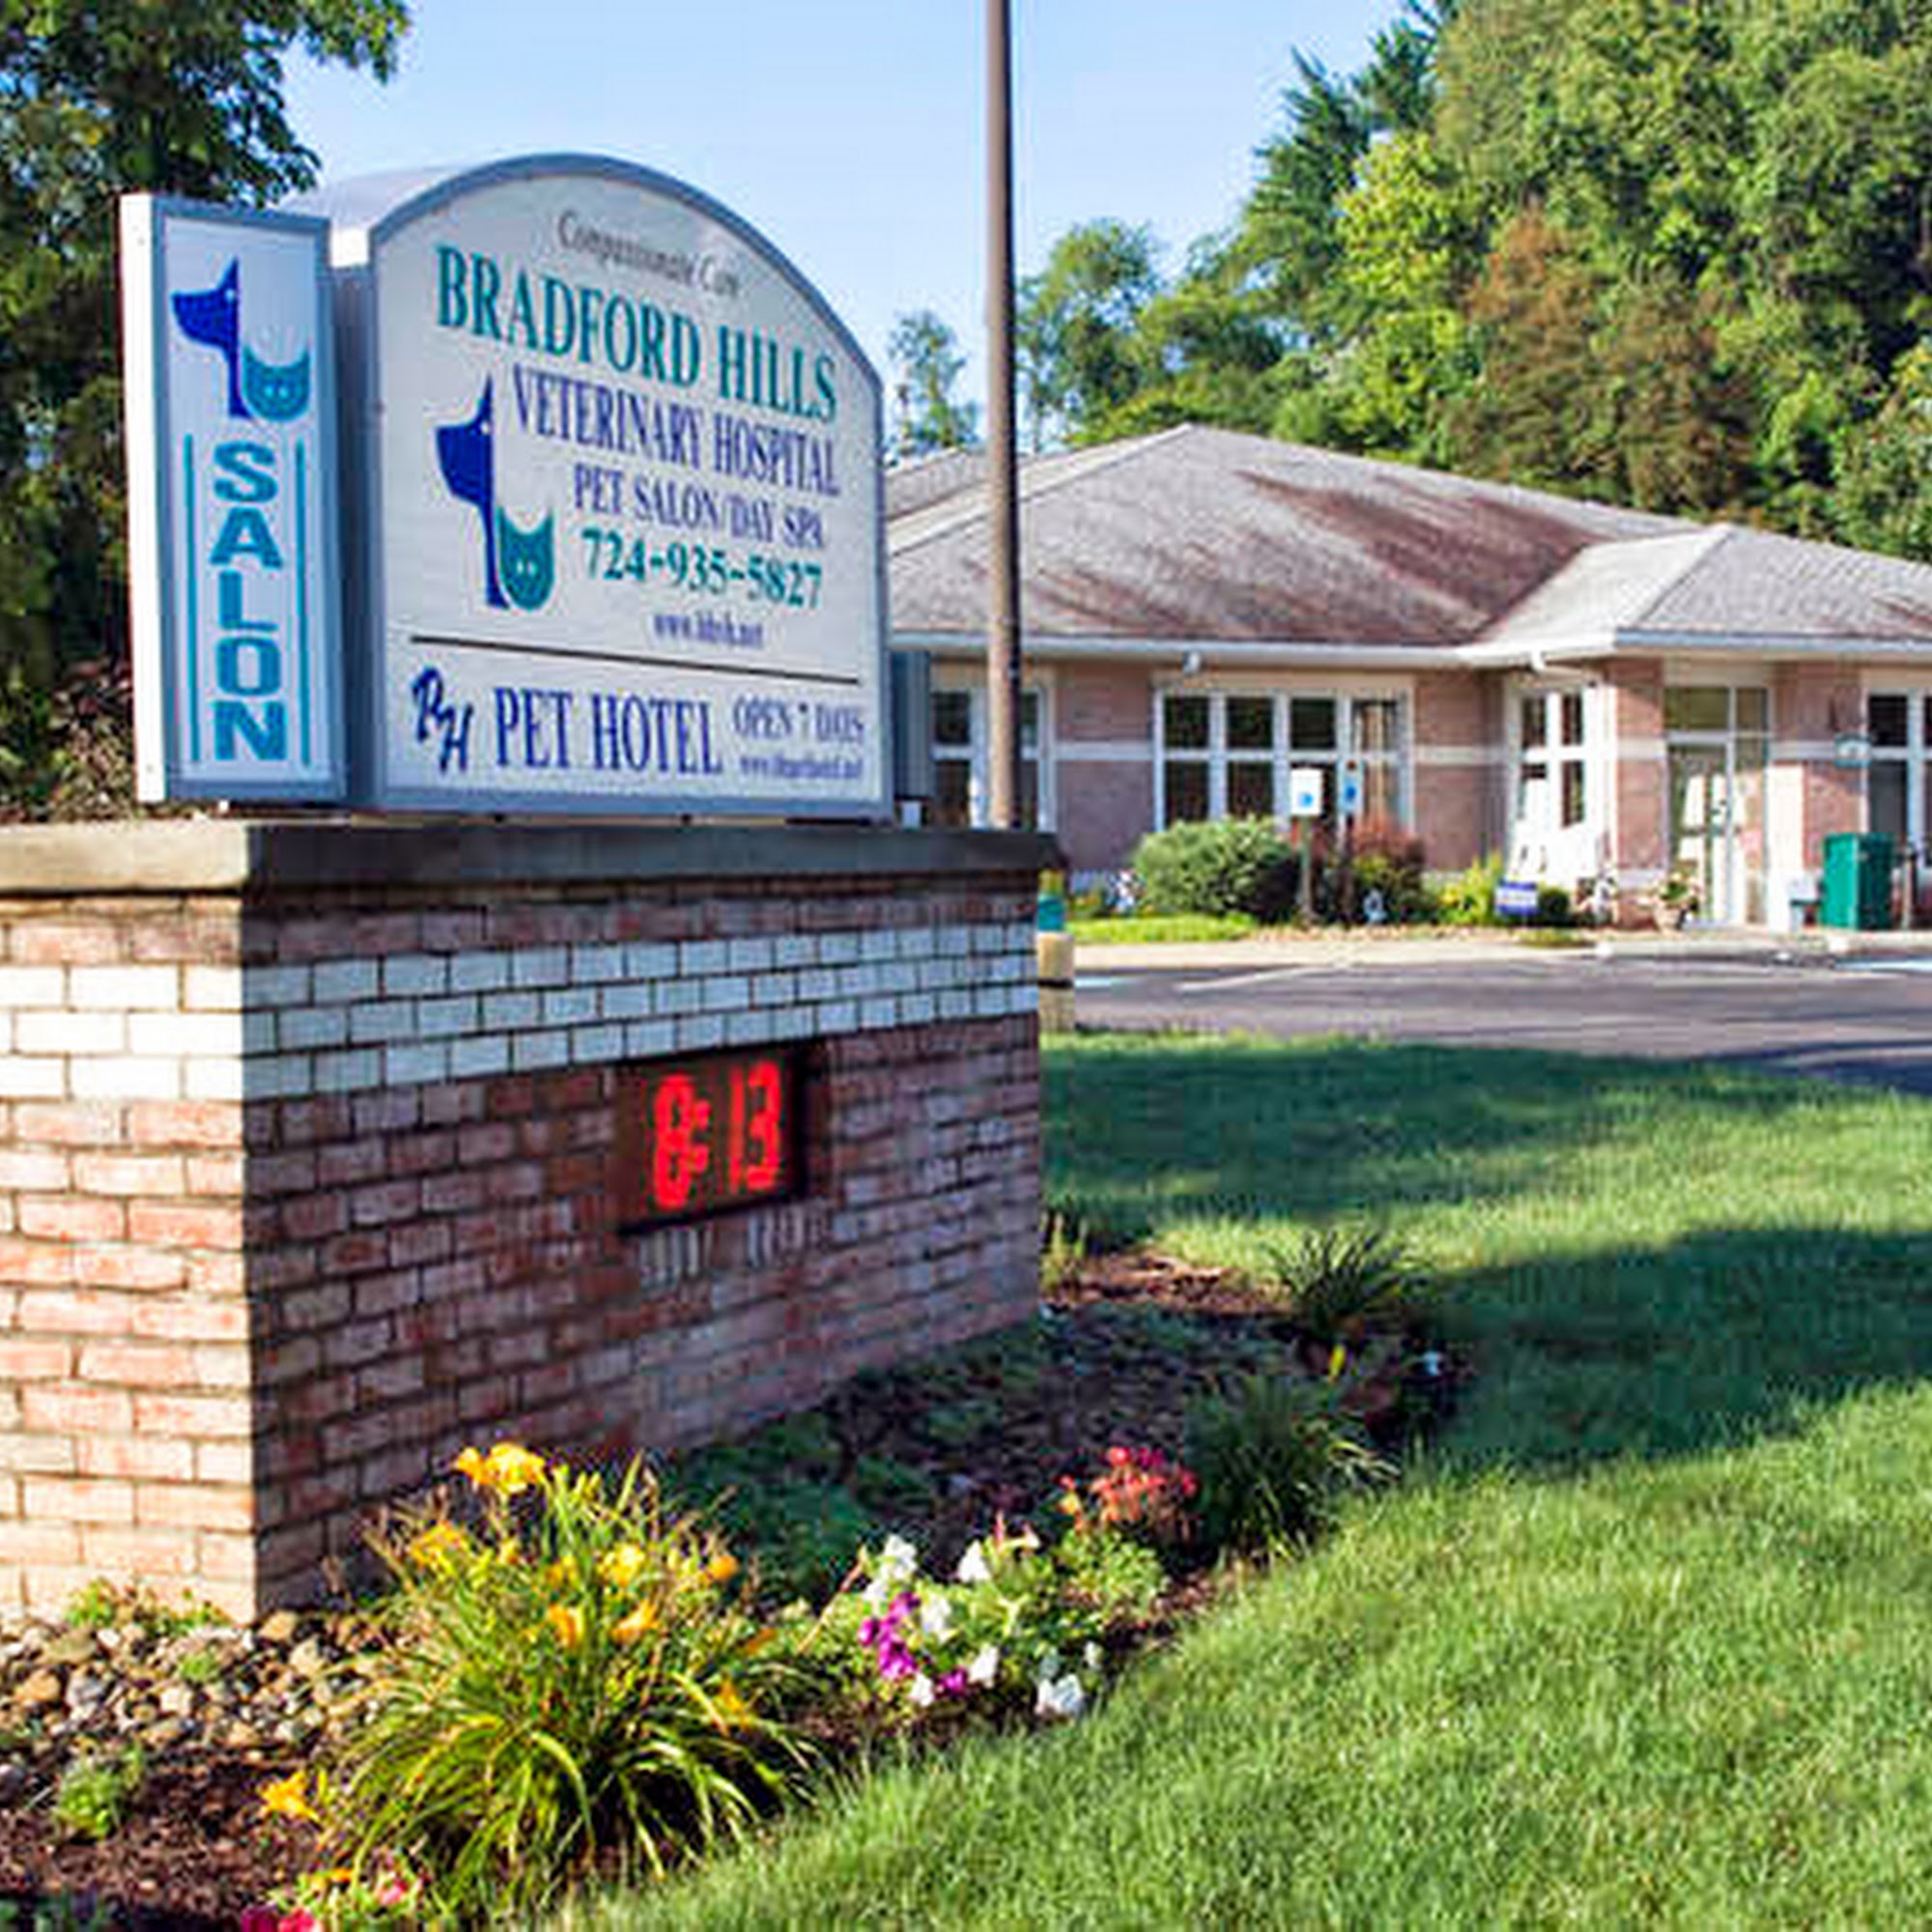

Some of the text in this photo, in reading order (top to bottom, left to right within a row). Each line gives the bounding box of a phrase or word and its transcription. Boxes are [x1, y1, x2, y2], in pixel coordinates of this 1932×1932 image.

[437, 244, 838, 422] BRADFORD HILLS
[512, 362, 838, 497] VETERINARY HOSPITAL
[574, 463, 625, 514] PET
[783, 505, 824, 550] SPA
[210, 441, 288, 761] SALON
[582, 527, 822, 610] 724-935-5827
[494, 688, 574, 767] PET
[590, 694, 724, 774] HOTEL
[733, 696, 792, 740] OPEN
[653, 1059, 781, 1211] 8:13
